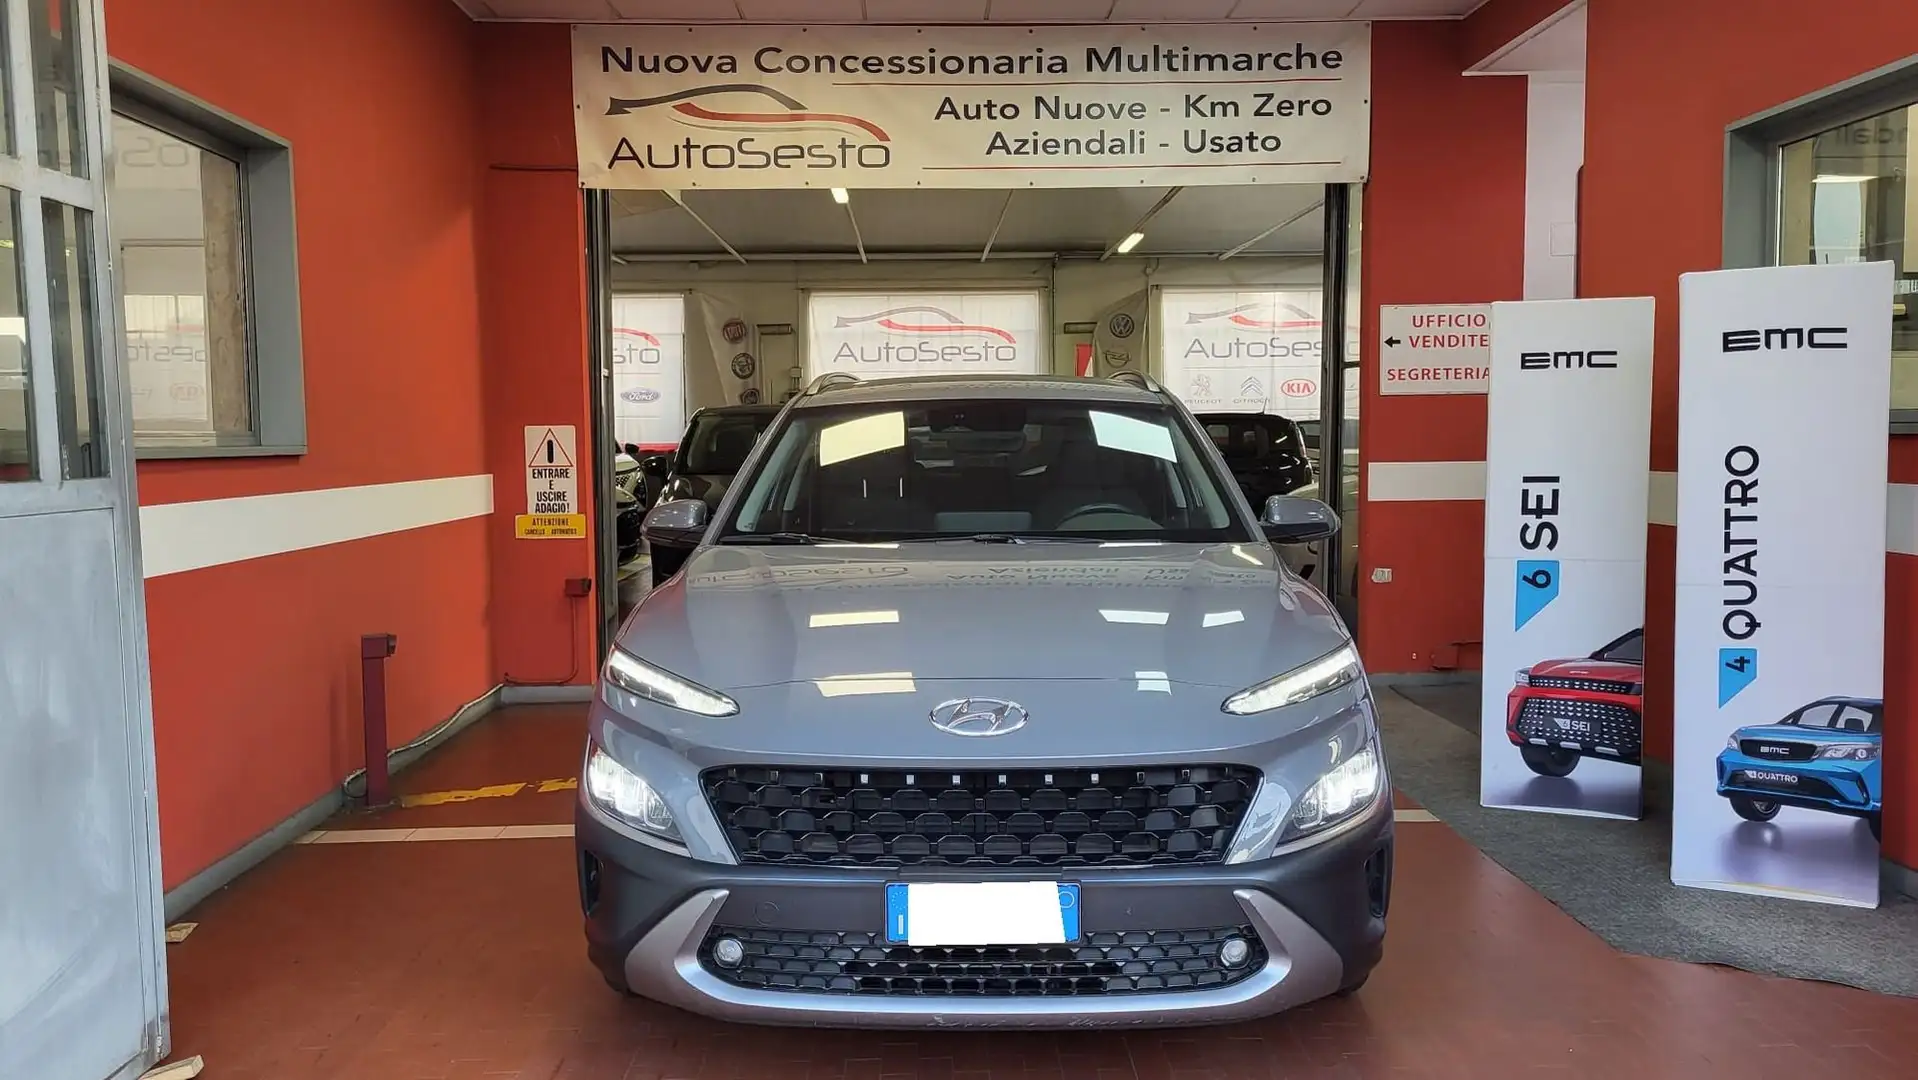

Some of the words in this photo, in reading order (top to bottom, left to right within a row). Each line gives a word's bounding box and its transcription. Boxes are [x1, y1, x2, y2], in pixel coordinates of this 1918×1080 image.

[601, 46, 737, 74] Nuova
[754, 46, 1068, 75] Concessionaria
[1086, 43, 1343, 73] Multimarche
[934, 96, 1020, 121] Auto
[1034, 95, 1147, 120] Nuove
[1184, 94, 1240, 118] Km
[1253, 92, 1332, 117] Zero
[985, 130, 1146, 156] Aziendali
[1184, 130, 1282, 154] Usato
[607, 136, 891, 170] AutoSesto
[1411, 313, 1487, 328] UFFICIO
[1408, 334, 1489, 348] VENDITE
[1722, 327, 1848, 354] EMC
[832, 341, 1017, 364] AutoSesto
[1520, 350, 1618, 370] EMC
[1386, 367, 1490, 381] SEGRETERIA
[626, 389, 656, 401] Ford
[1286, 382, 1312, 394] KIA
[531, 468, 570, 479] ENTRARE
[549, 479, 554, 490] E
[536, 491, 567, 502] USCIRE
[535, 502, 570, 514] ADAGIO!
[1519, 475, 1560, 551] SEI
[532, 518, 569, 526] ATTENZIONE
[1722, 445, 1762, 641] QUATTRO
[1522, 569, 1552, 589] 6
[1725, 655, 1751, 673] 4
[1571, 720, 1590, 732] SEI
[1757, 771, 1798, 783] QUATTRO
